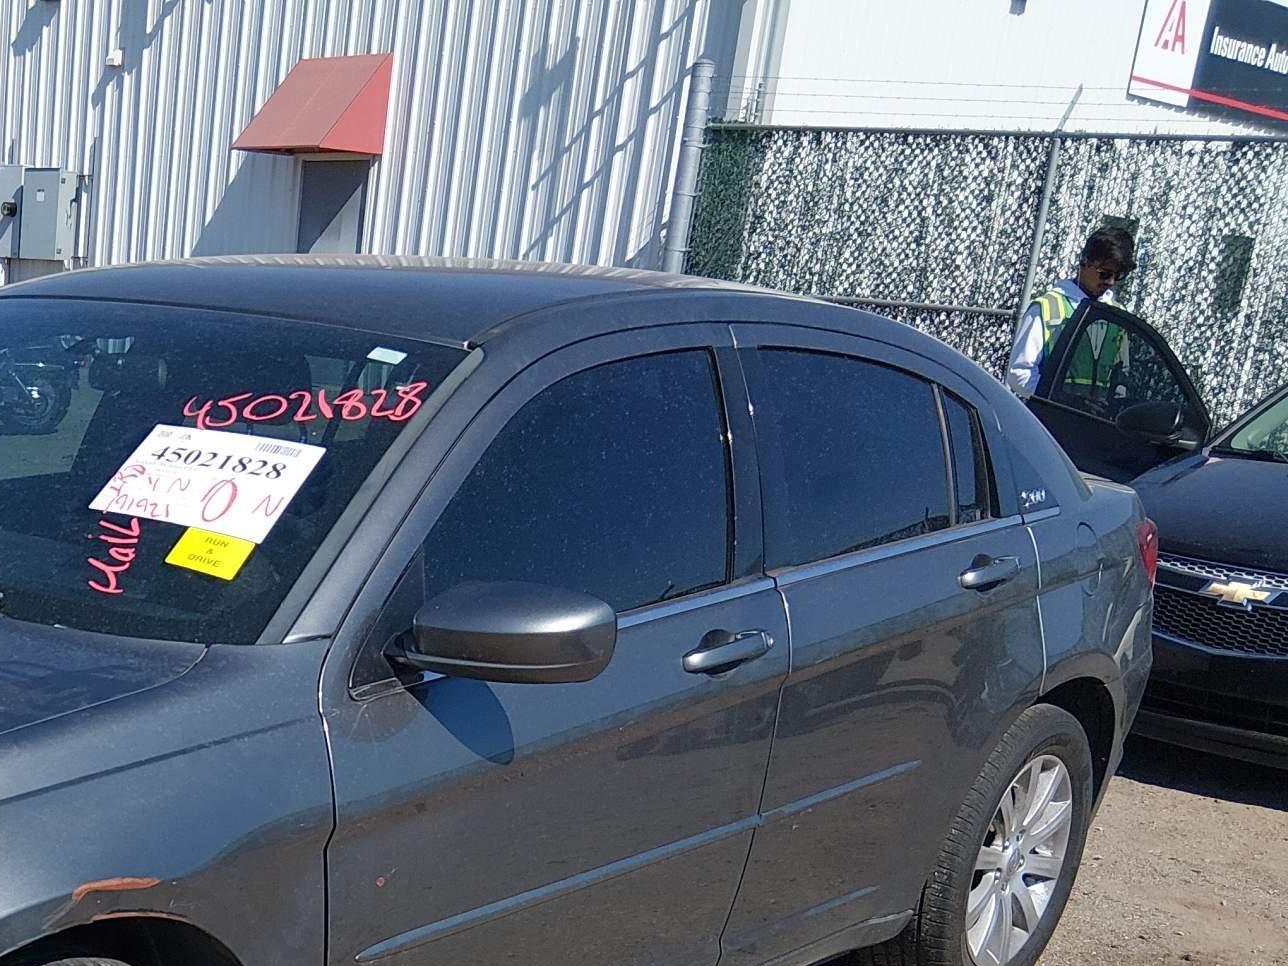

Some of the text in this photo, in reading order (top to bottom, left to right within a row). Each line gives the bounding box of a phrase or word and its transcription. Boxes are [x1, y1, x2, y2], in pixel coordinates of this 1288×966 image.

[1209, 26, 1266, 67] Insurance
[183, 382, 428, 430] 45021828
[152, 446, 287, 480] 45021828
[204, 536, 230, 548] RUN
[187, 552, 222, 568] DRIVE
